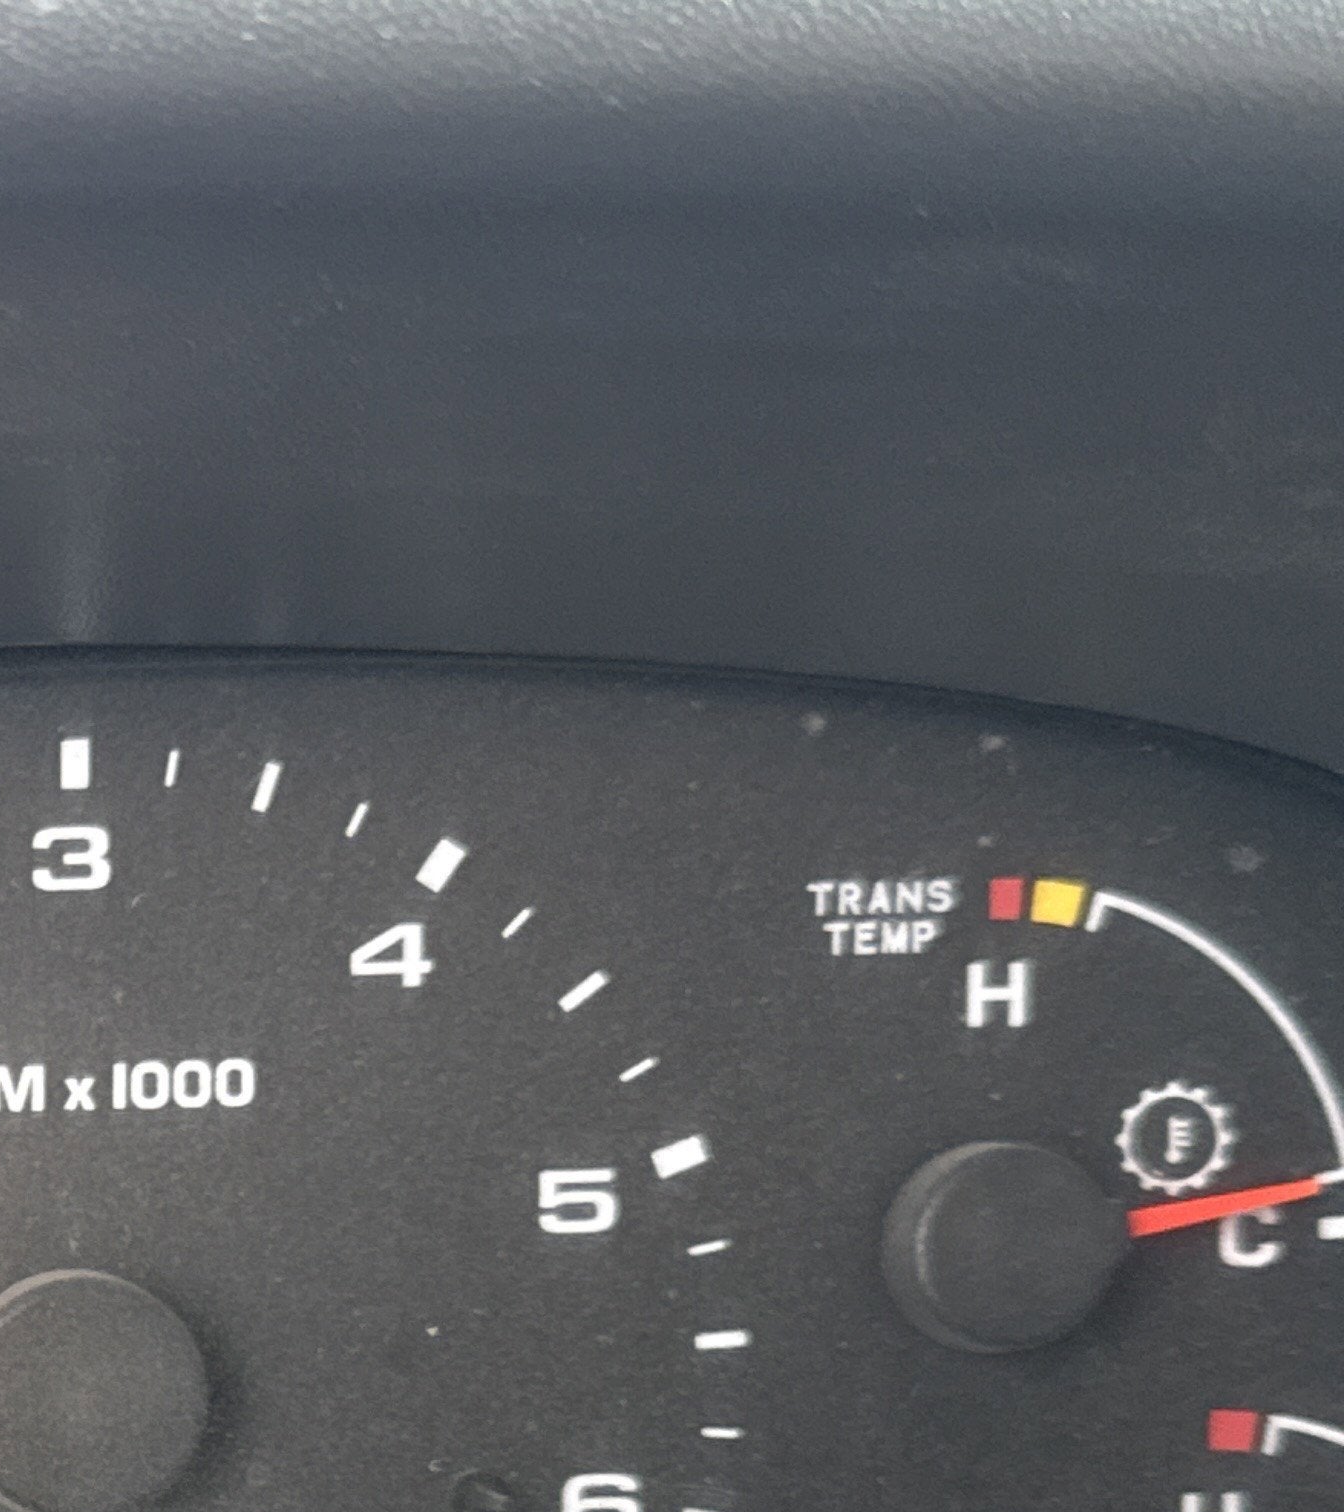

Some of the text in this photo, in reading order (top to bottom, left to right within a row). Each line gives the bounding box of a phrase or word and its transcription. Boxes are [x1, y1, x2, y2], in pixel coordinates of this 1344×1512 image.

[32, 825, 112, 892] 3
[806, 878, 957, 916] TRANS
[350, 922, 433, 988] 4
[823, 919, 940, 956] TEMP
[966, 960, 1030, 1028] H
[538, 1168, 618, 1234] 5
[1219, 1206, 1282, 1267] C
